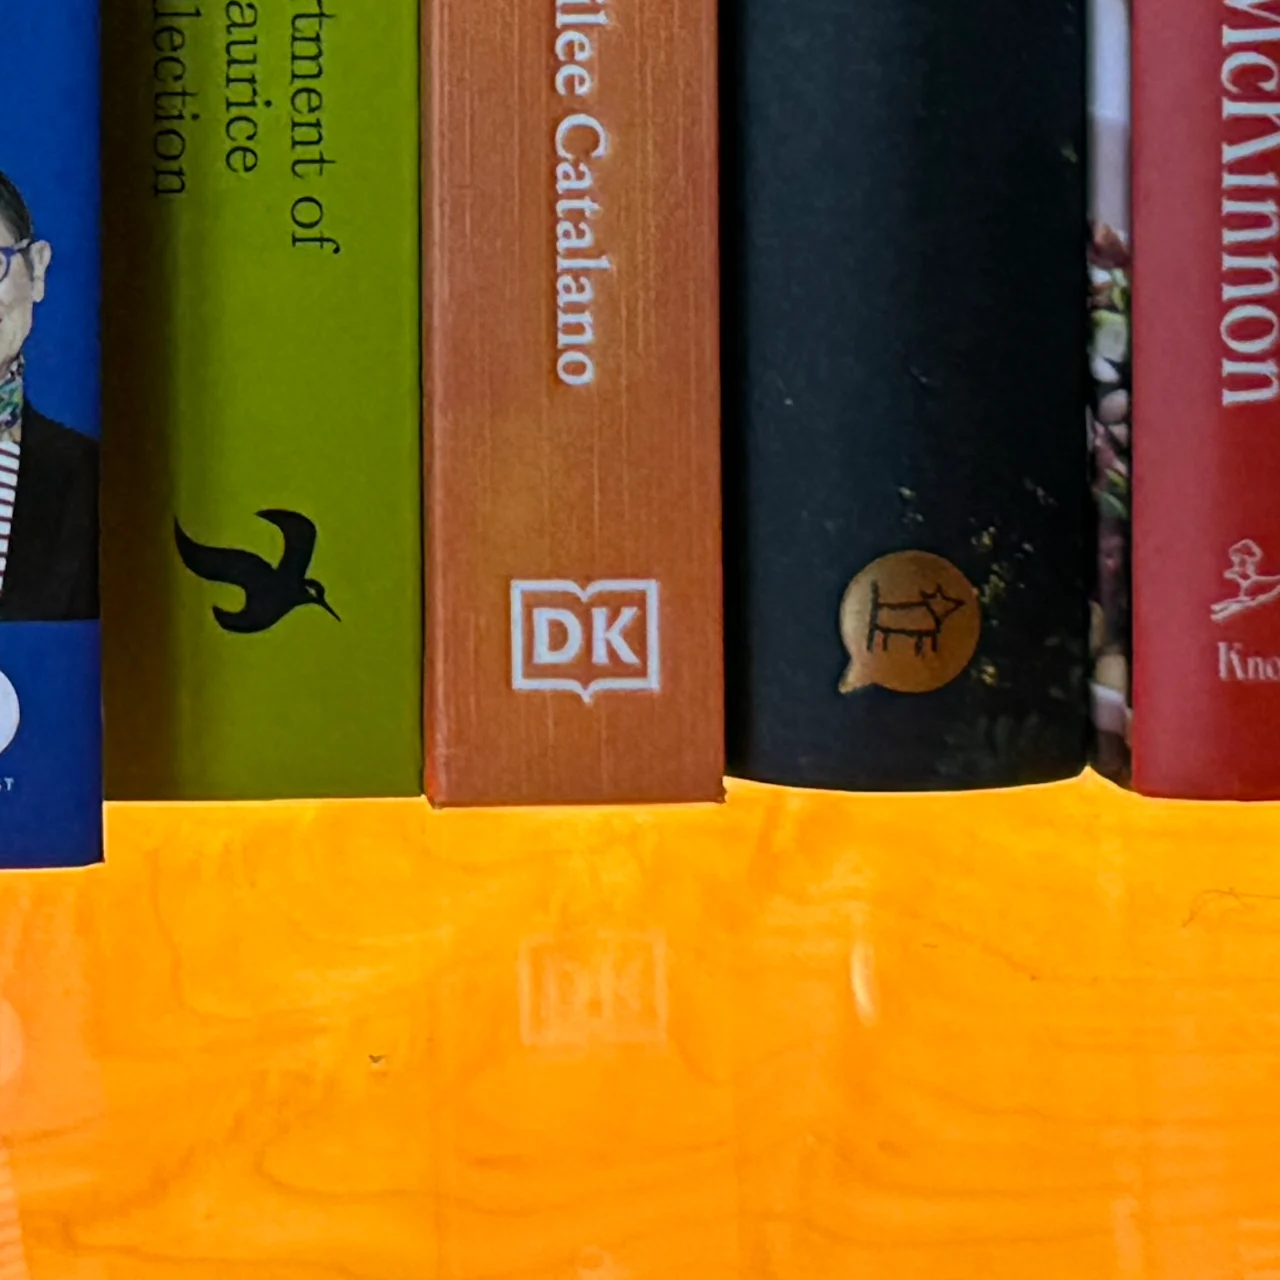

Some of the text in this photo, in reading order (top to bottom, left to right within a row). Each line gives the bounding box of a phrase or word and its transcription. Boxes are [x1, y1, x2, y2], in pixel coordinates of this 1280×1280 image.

[288, 195, 340, 253] of
[553, 112, 608, 387] Catalano
[532, 606, 639, 665] DK
